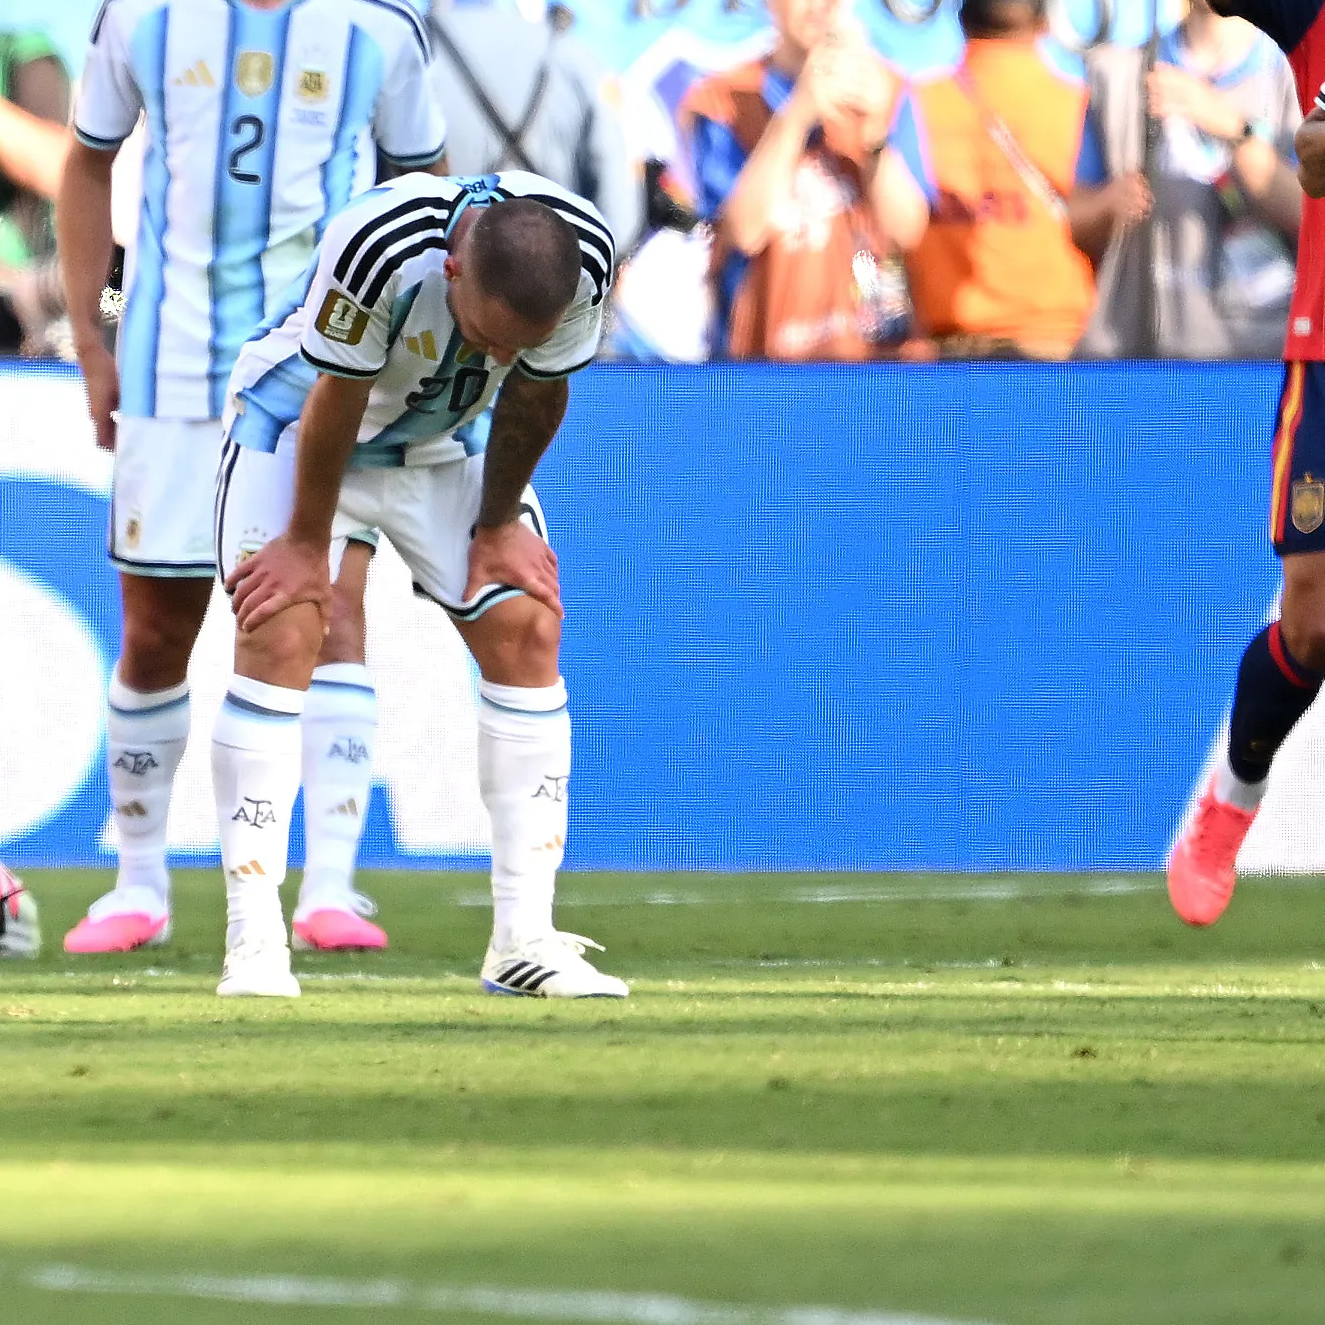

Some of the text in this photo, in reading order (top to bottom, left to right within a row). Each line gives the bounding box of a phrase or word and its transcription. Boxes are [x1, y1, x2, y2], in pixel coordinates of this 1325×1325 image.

[229, 114, 264, 185] 2
[404, 366, 490, 414] 20
[231, 796, 277, 829] AFA
